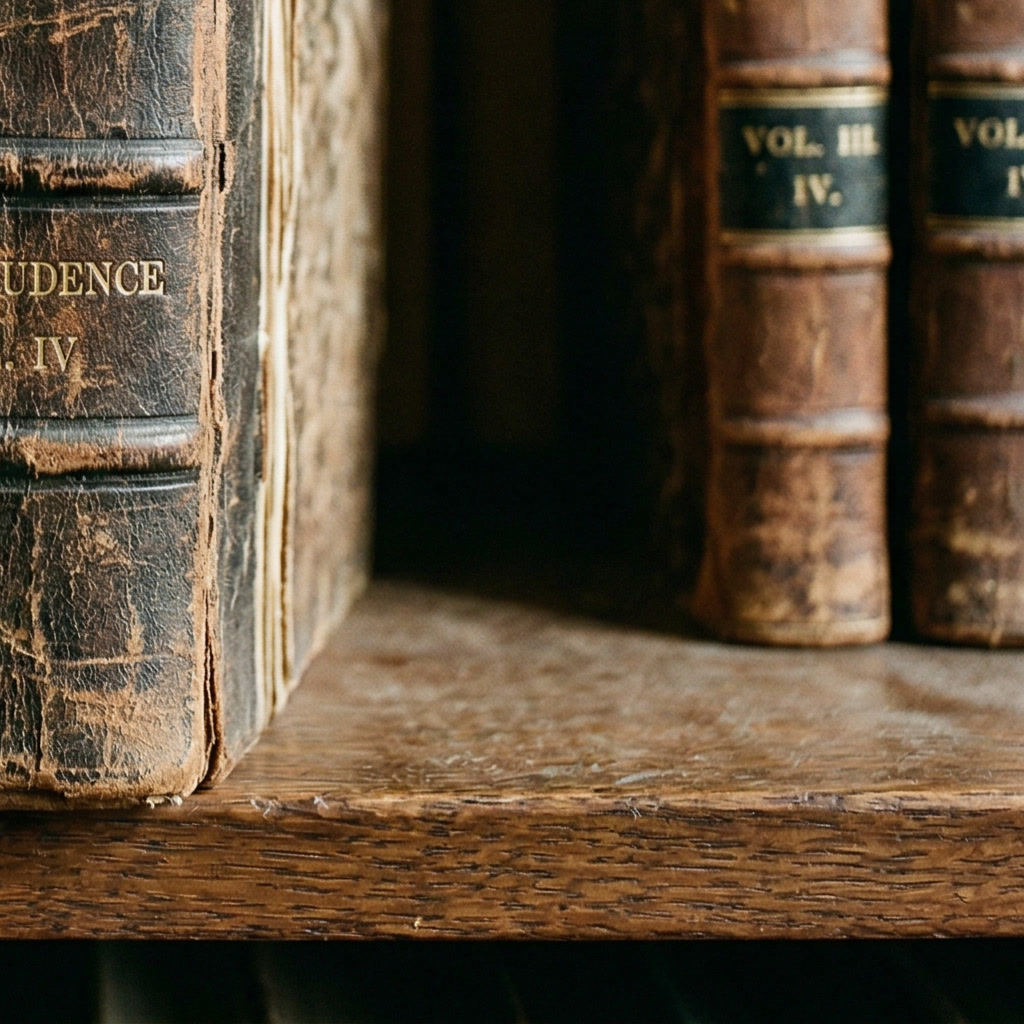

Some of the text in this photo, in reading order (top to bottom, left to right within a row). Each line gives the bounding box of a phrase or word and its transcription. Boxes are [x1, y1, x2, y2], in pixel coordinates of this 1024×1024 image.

[742, 124, 825, 157] VOL.
[793, 173, 843, 207] IV.
[33, 335, 78, 373] IV
